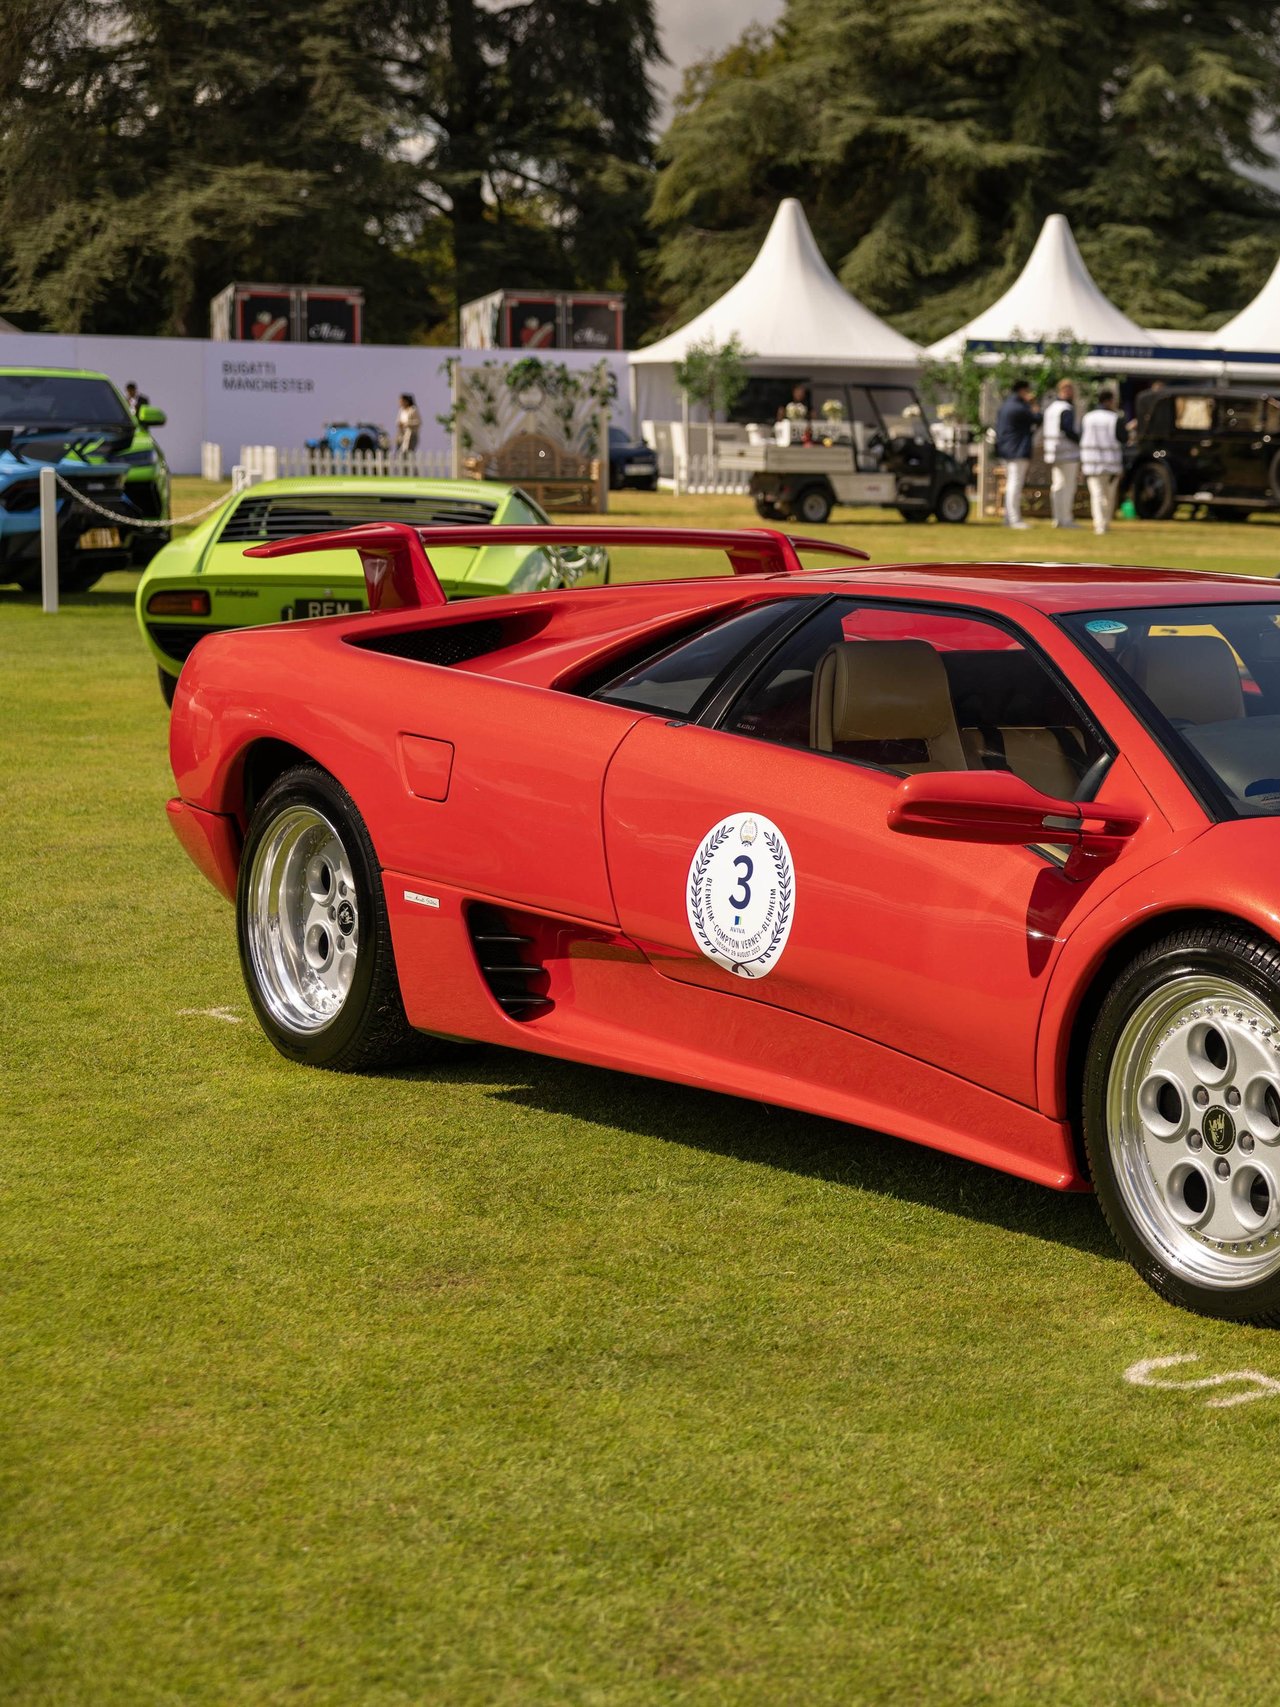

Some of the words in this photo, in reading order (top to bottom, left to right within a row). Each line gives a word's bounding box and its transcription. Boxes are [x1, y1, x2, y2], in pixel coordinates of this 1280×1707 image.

[223, 361, 276, 375] BUGATTI
[223, 377, 315, 393] MANCHESTER
[728, 854, 754, 910] 3
[705, 877, 715, 922] BLENHEIM
[713, 924, 740, 949] COMPTON
[741, 931, 762, 950] VERNEY
[761, 888, 776, 932] BLENHEIM
[730, 926, 746, 934] AVIVA
